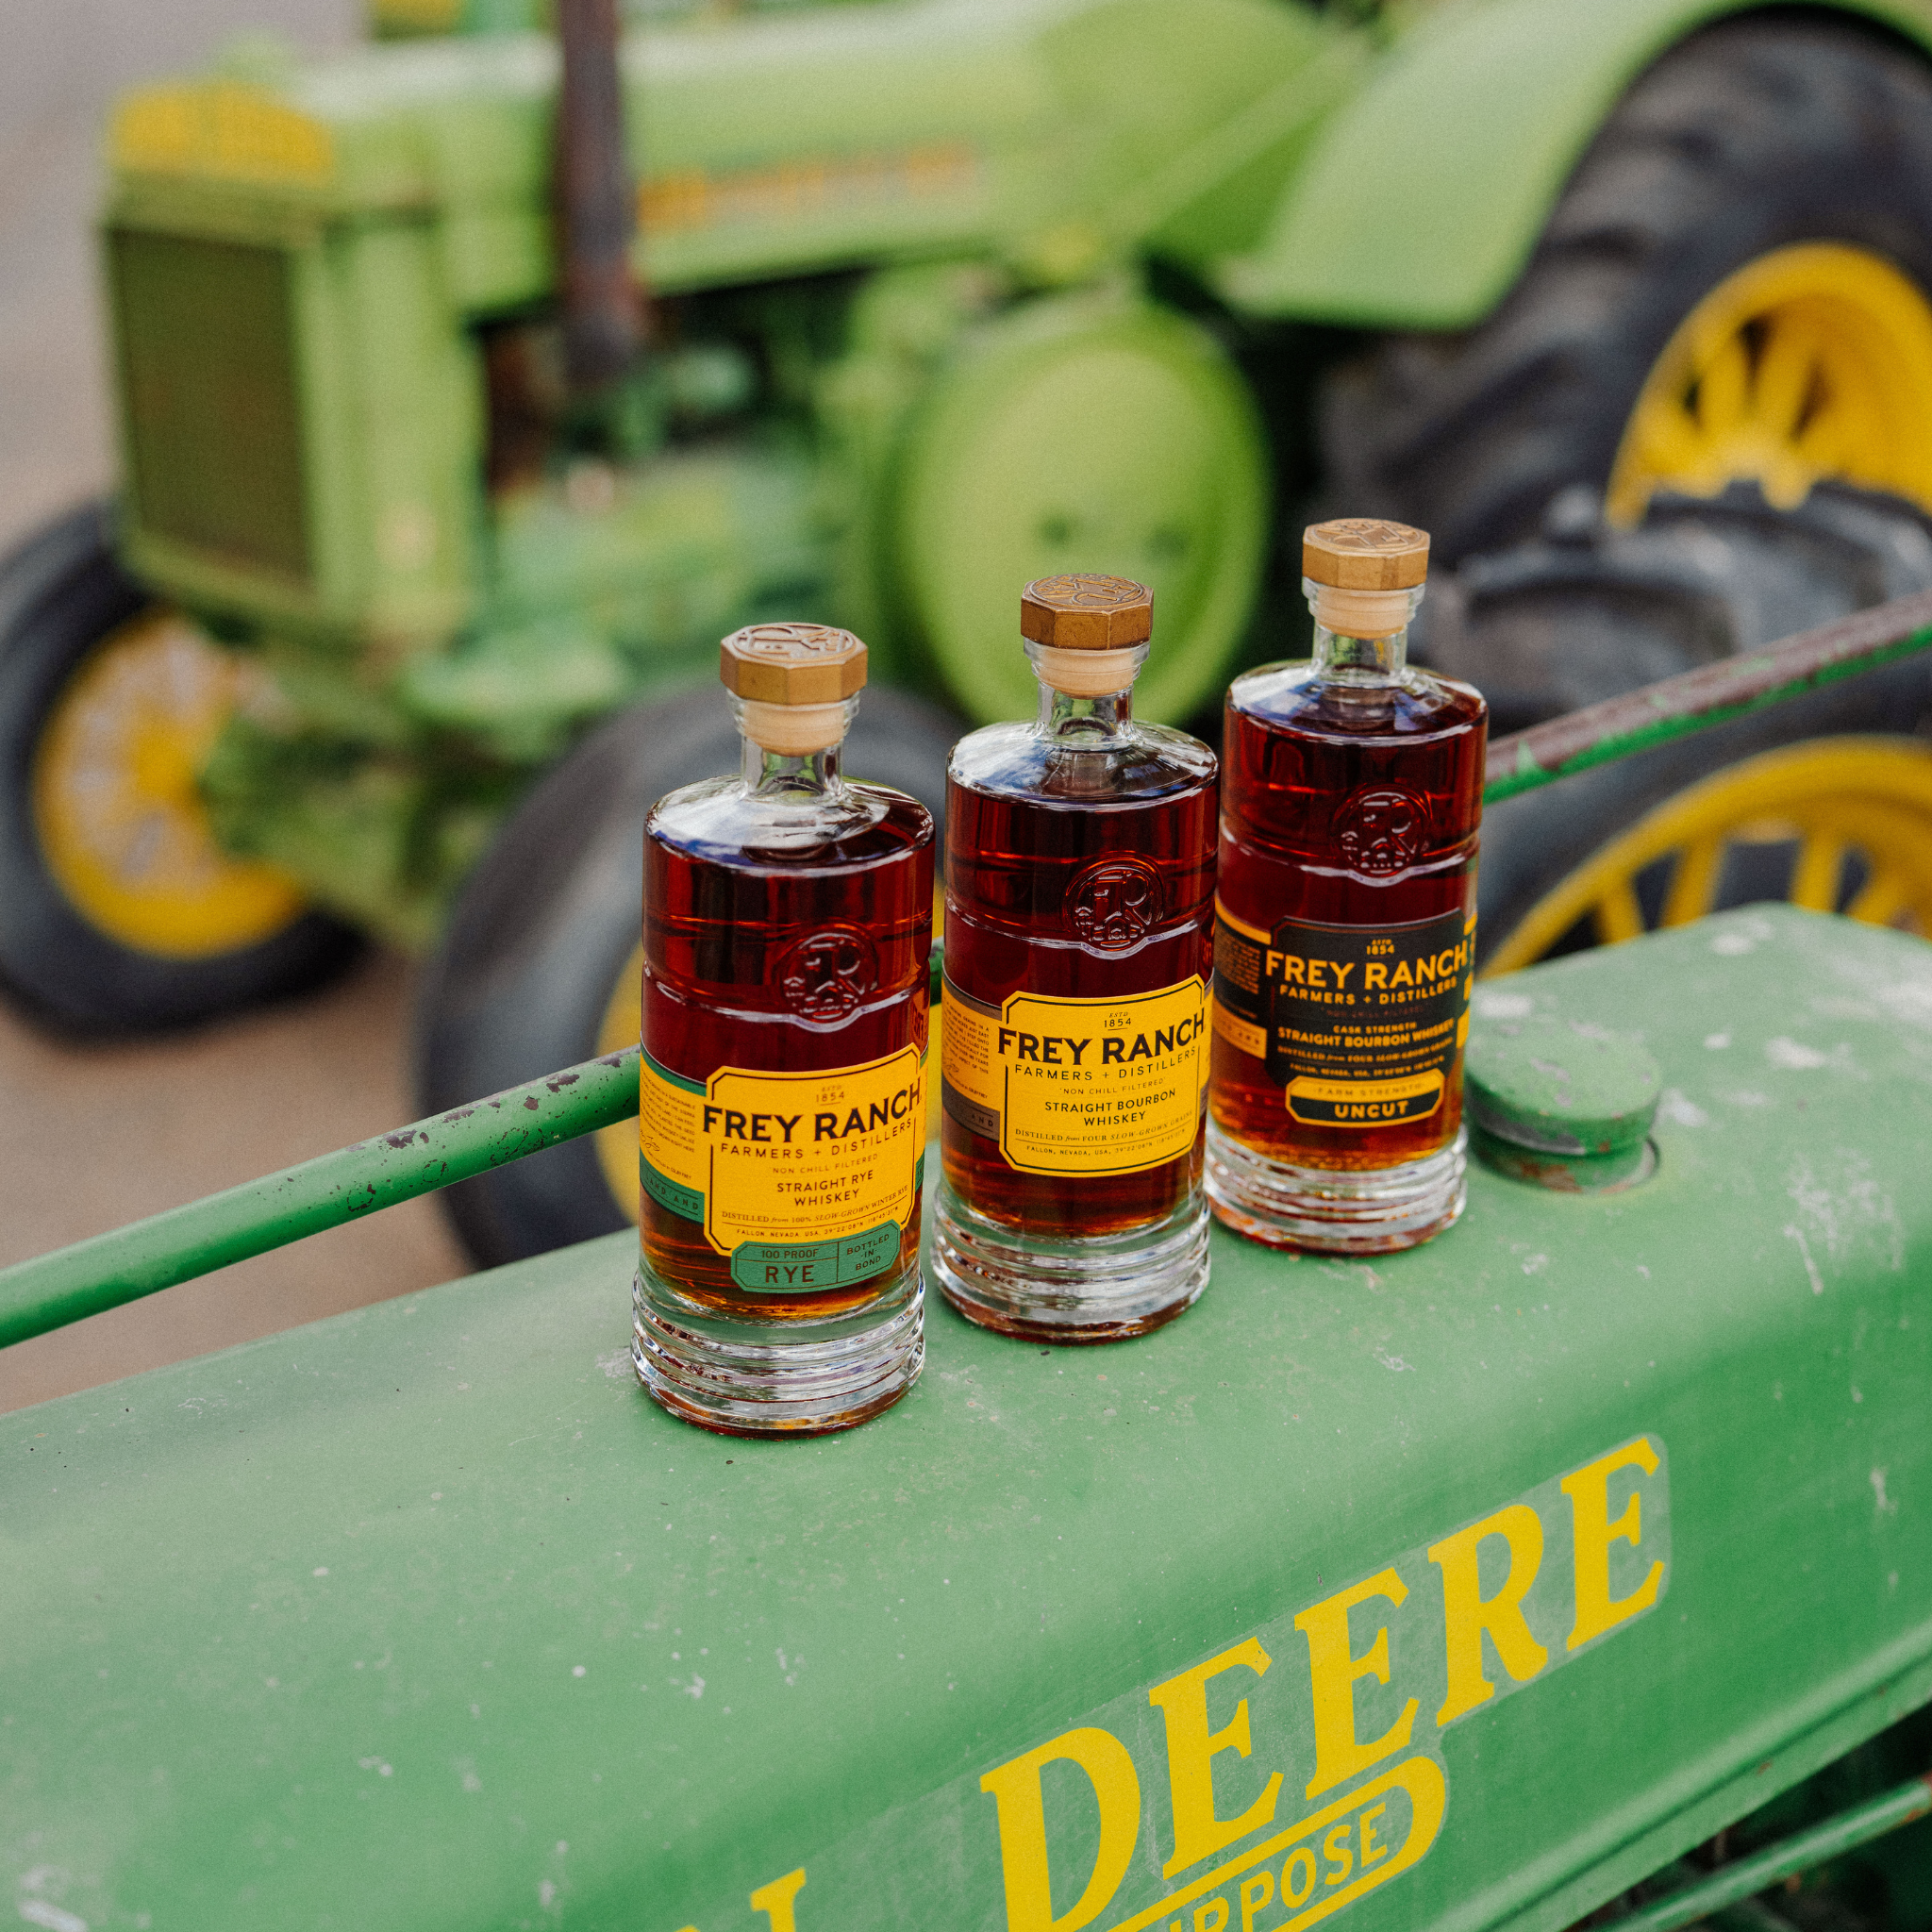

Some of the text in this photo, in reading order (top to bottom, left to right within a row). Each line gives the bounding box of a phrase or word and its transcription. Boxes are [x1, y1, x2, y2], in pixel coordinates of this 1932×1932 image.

[1366, 945, 1394, 955] 1854
[1266, 949, 1356, 990] FREY
[1364, 940, 1468, 991] RANCH
[1279, 984, 1356, 1006] FARMERS
[1379, 975, 1457, 1005] DISTILLERS
[1104, 1017, 1132, 1028] 1854
[998, 1026, 1092, 1065] FREY
[1102, 1007, 1205, 1064] RANCH
[1277, 1026, 1341, 1047] STRAIGHT
[1344, 1033, 1409, 1047] BOURBON
[1015, 1064, 1092, 1081] FARMERS
[1119, 1045, 1196, 1078] DISTILLERS
[816, 1091, 844, 1102] 1854
[1045, 1089, 1175, 1113] STRAIGHT BOURBON
[703, 1104, 804, 1143] FREY
[813, 1076, 921, 1141] RANCH
[1083, 1111, 1146, 1126] WHISKEY
[1334, 1100, 1408, 1119] UNCUT
[721, 1143, 804, 1158] FARMERS
[832, 1117, 911, 1155] DISTILLERS
[1015, 1128, 1063, 1141] DISTILLED
[800, 1165, 830, 1174] CHILL
[835, 1153, 877, 1170] FILTERED
[777, 1170, 874, 1192] STRAIGHT RYE
[674, 1195, 698, 1210] AND
[723, 1211, 770, 1223] DISTILLED
[815, 1204, 870, 1221] SLOW-GROWN
[872, 1192, 897, 1208] WINTER
[898, 1185, 908, 1196] RYE
[794, 1189, 859, 1206] WHISKEY
[762, 1249, 819, 1258] 100 PROOF
[847, 1234, 890, 1255] BOTTLED
[765, 1264, 815, 1284] RYE
[856, 1256, 881, 1271] BOND
[978, 1436, 1665, 1932] DEERE
